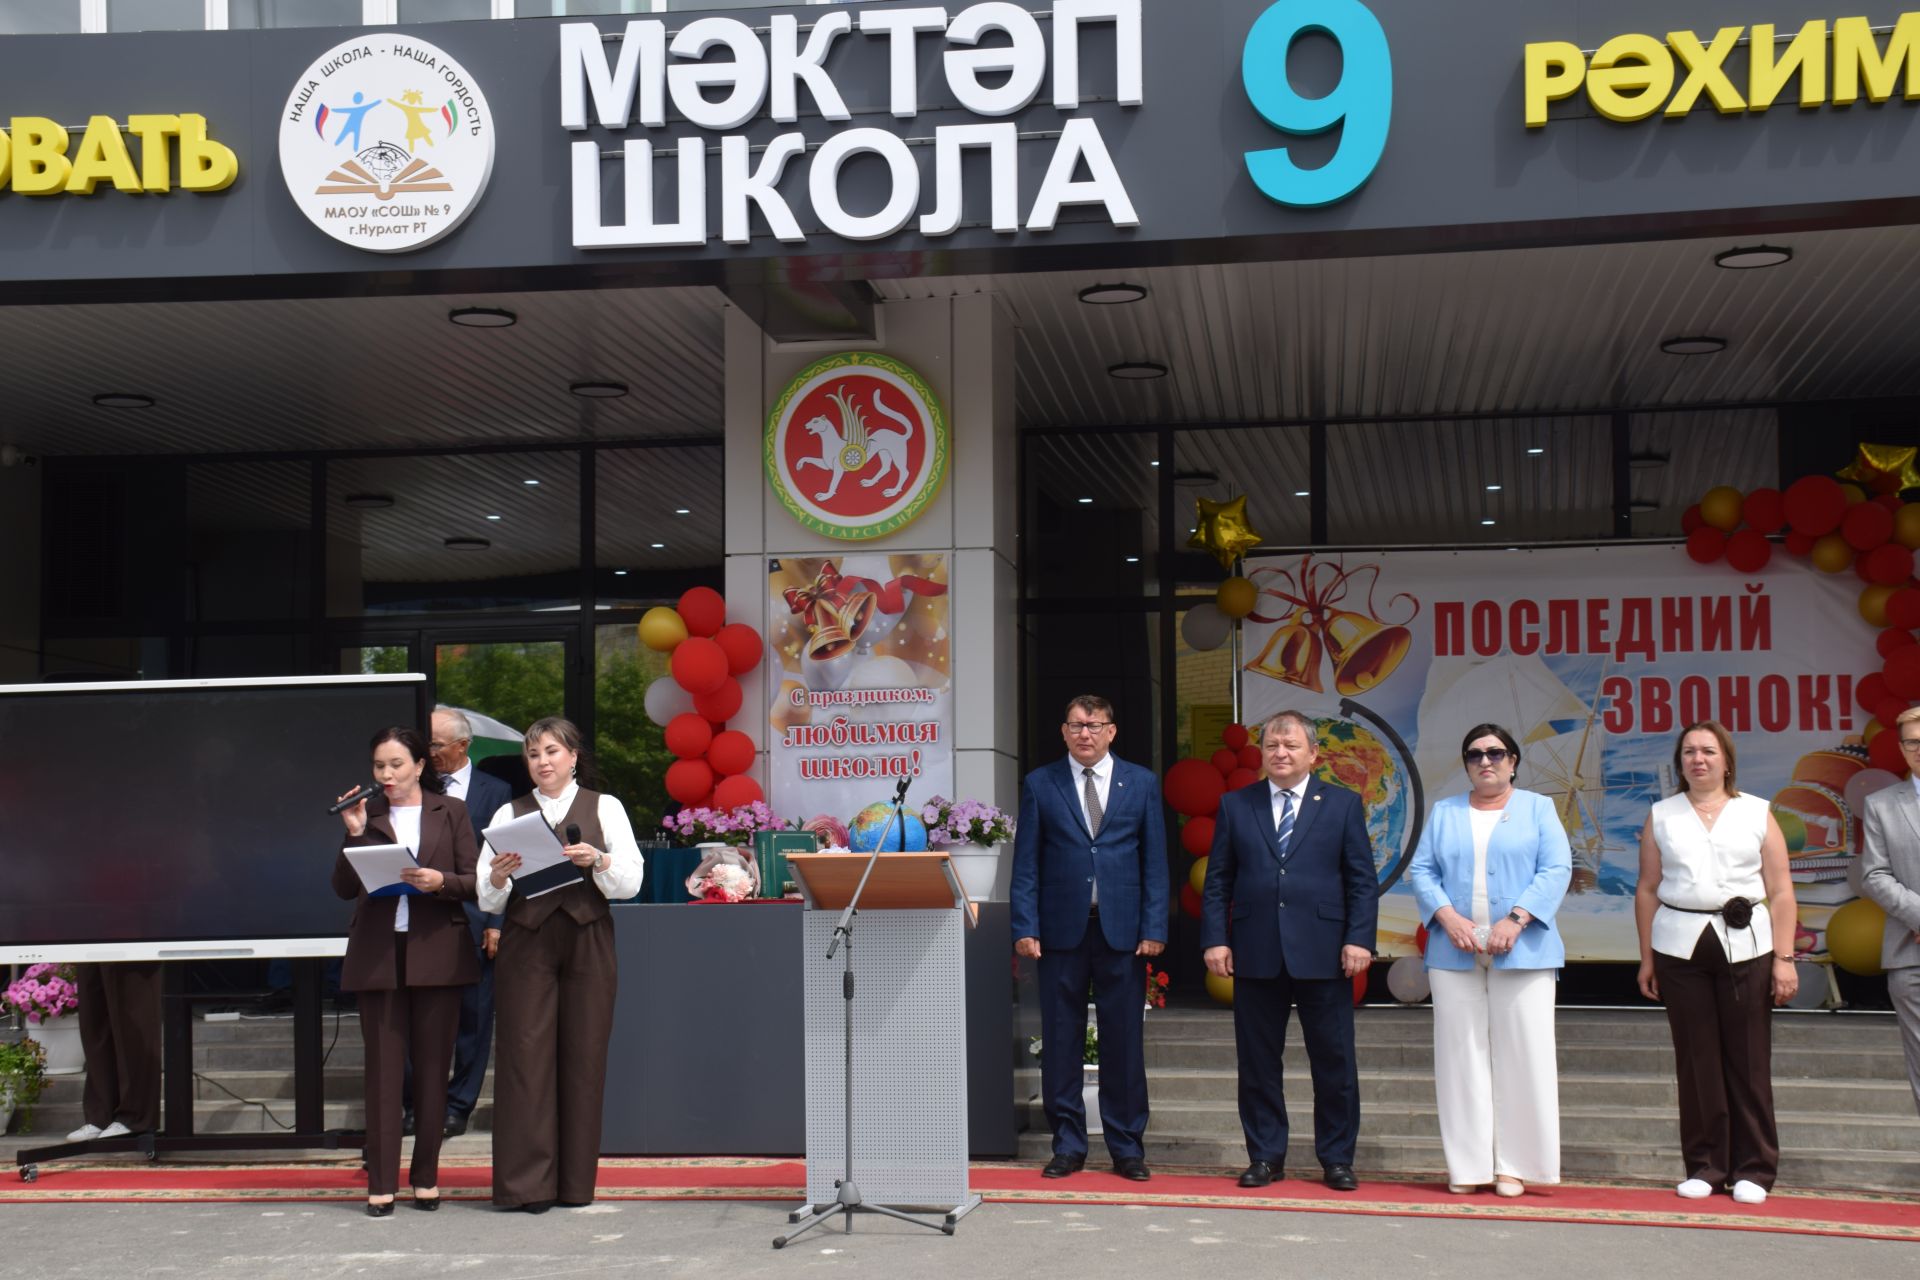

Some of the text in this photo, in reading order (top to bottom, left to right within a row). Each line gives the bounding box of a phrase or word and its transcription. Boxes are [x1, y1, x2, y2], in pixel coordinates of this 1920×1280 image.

[290, 80, 319, 122] НАША
[320, 46, 373, 77] ШКОЛА
[393, 45, 436, 69] НАША
[438, 64, 482, 137] ГОРДОСТЬ
[560, 0, 1143, 130] МӘКТӘП
[1242, 0, 1393, 208] 9
[0, 113, 239, 196] ВАТЬ
[571, 118, 1140, 249] ШКОЛА
[324, 204, 450, 218] МАОУ «СОШ» № 9
[349, 222, 427, 237] г.Нурлат РТ
[806, 515, 906, 538] ТАТАРСТАН
[1434, 583, 1771, 663] ПОСЛЕДНИЙ
[791, 688, 934, 709] С праздником,
[1602, 674, 1853, 734] ЗВОНОК!
[784, 716, 939, 747] любимая
[800, 750, 921, 779] школа!
